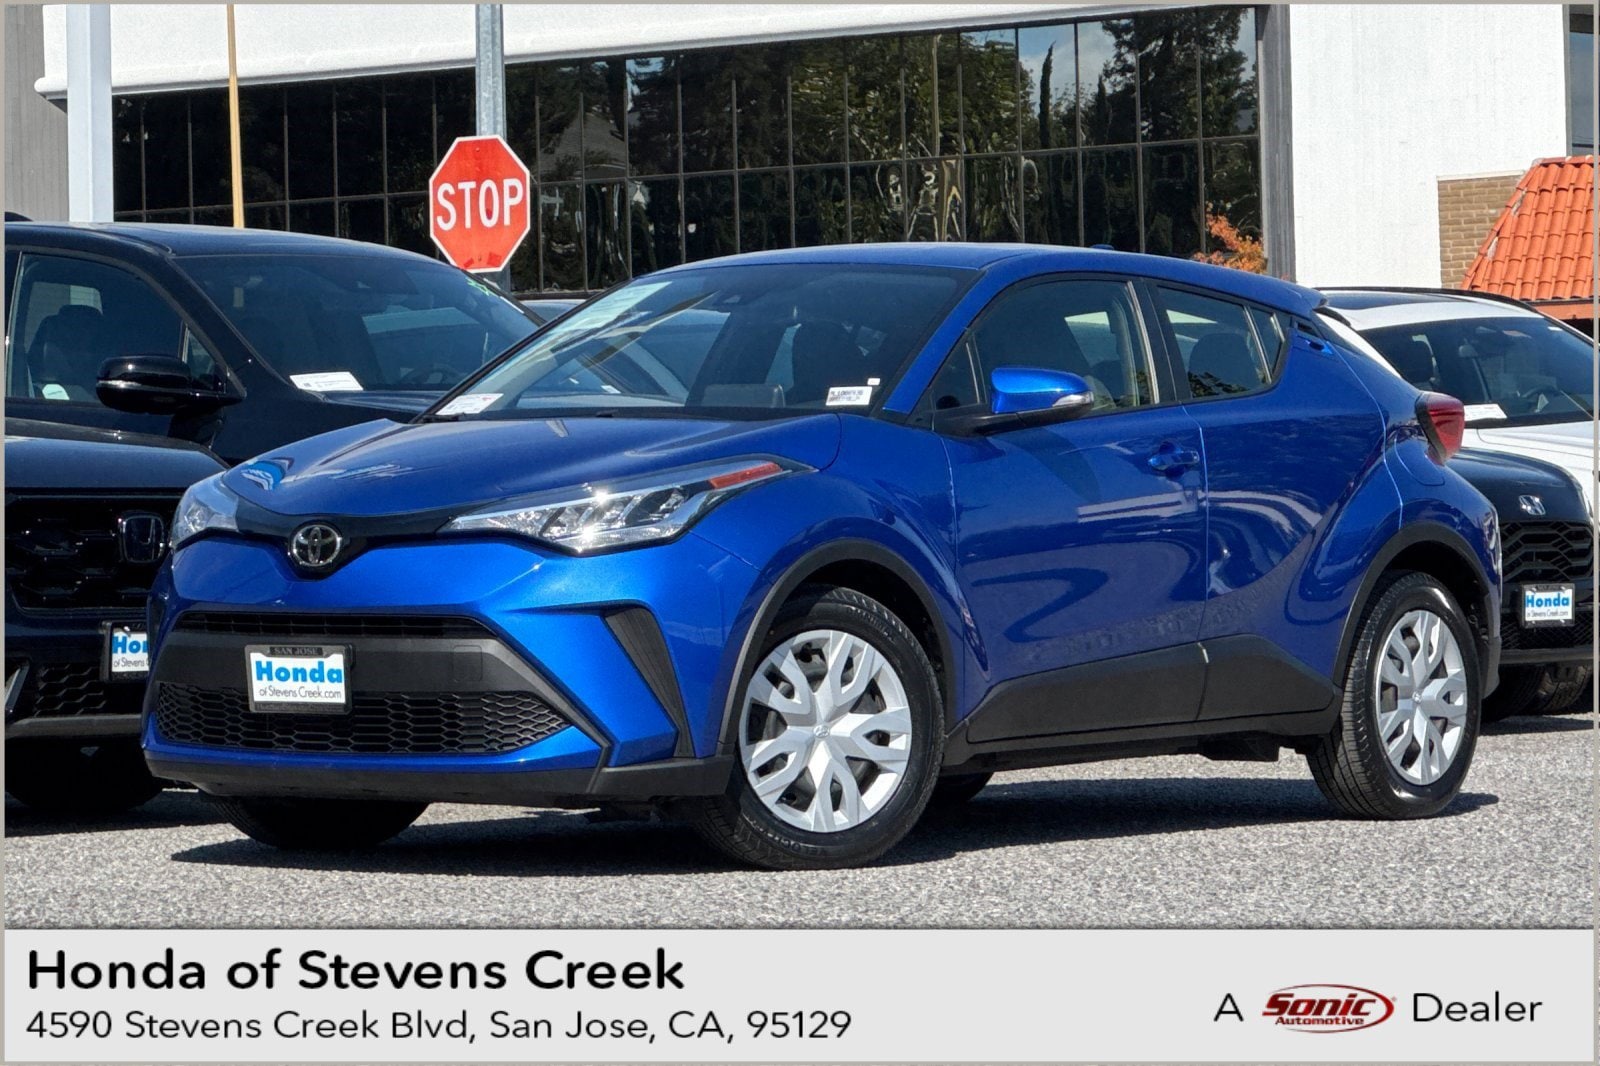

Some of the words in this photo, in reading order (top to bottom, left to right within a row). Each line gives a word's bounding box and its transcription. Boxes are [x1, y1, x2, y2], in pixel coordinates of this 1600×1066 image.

[436, 177, 524, 231] STOP
[1525, 593, 1570, 608] Honda
[274, 647, 293, 655] SAN
[295, 647, 319, 655] JOSE
[121, 657, 145, 668] Stevens
[255, 660, 343, 683] Honda
[259, 686, 268, 697] of
[268, 684, 297, 698] Stevens
[298, 685, 342, 699] Creek.com
